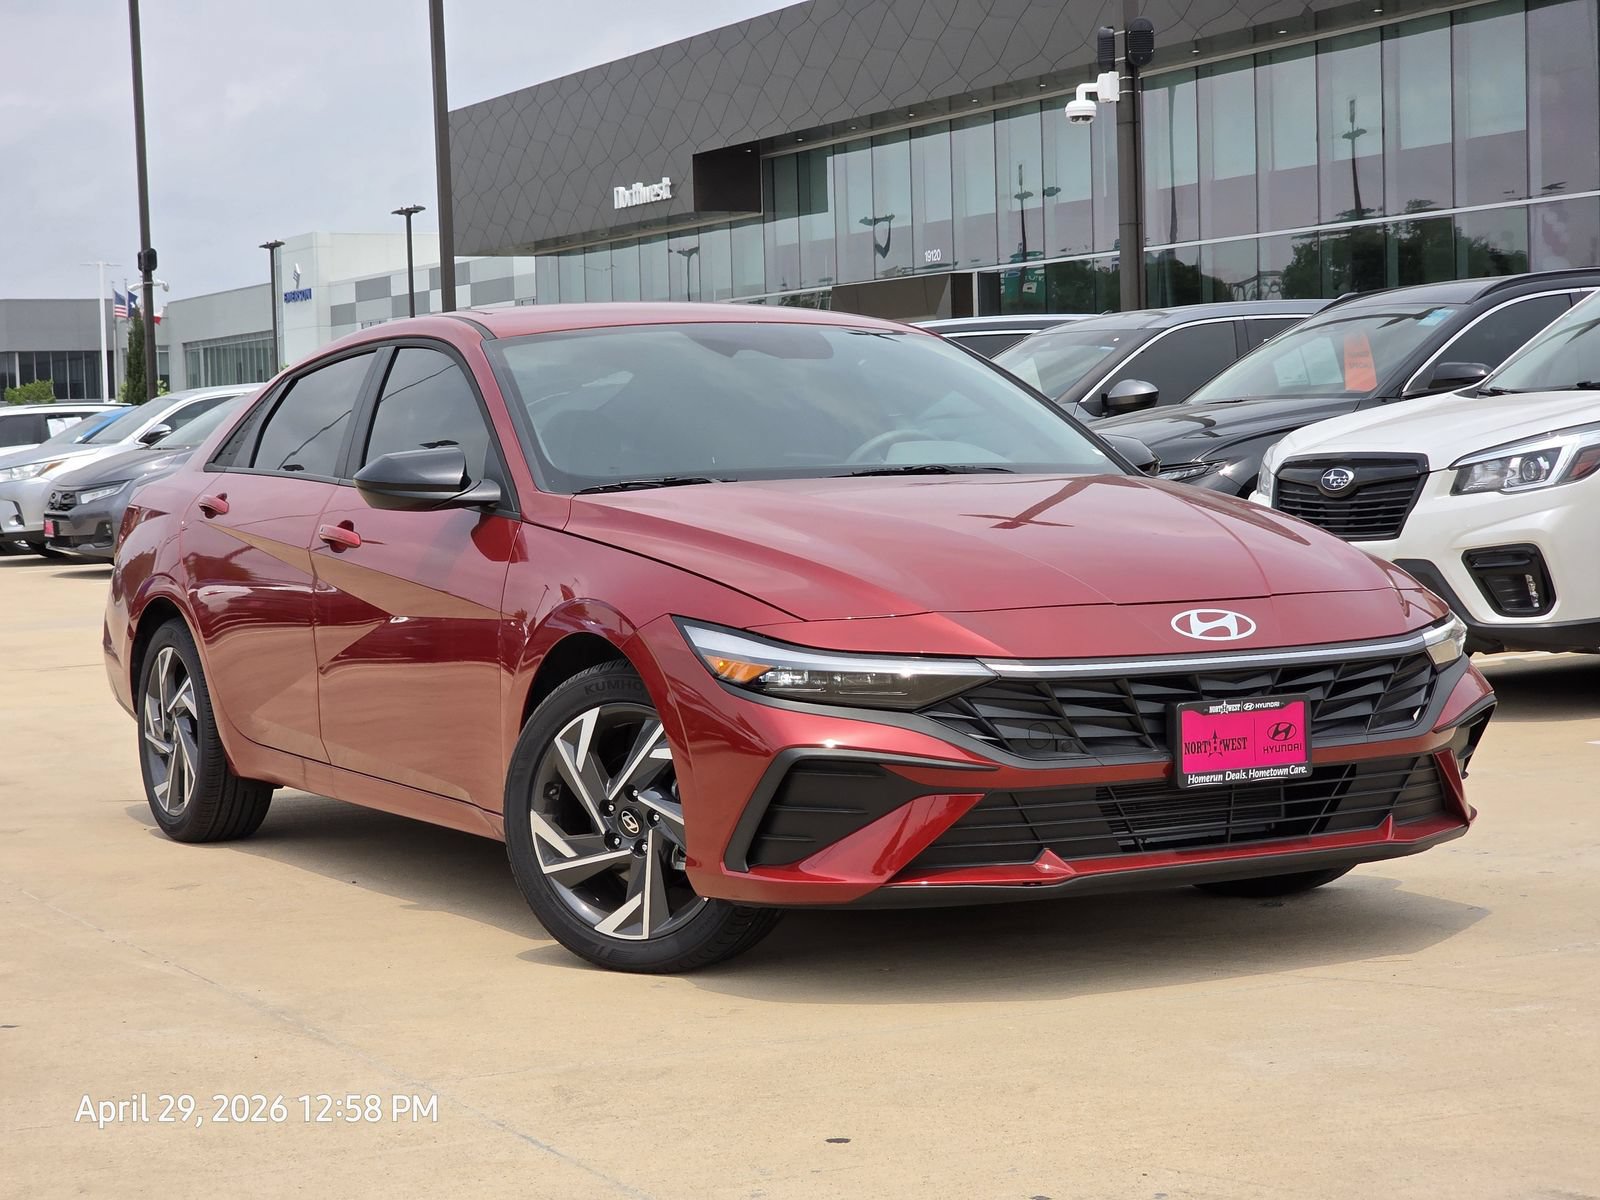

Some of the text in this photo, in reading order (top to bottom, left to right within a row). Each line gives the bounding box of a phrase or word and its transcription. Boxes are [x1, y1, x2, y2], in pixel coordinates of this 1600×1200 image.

[924, 249, 942, 262] 19120
[583, 679, 644, 695] KUMHO
[1263, 743, 1302, 753] HYUNDAI
[1188, 765, 1307, 784] Homerun Deals. Hometown Care.
